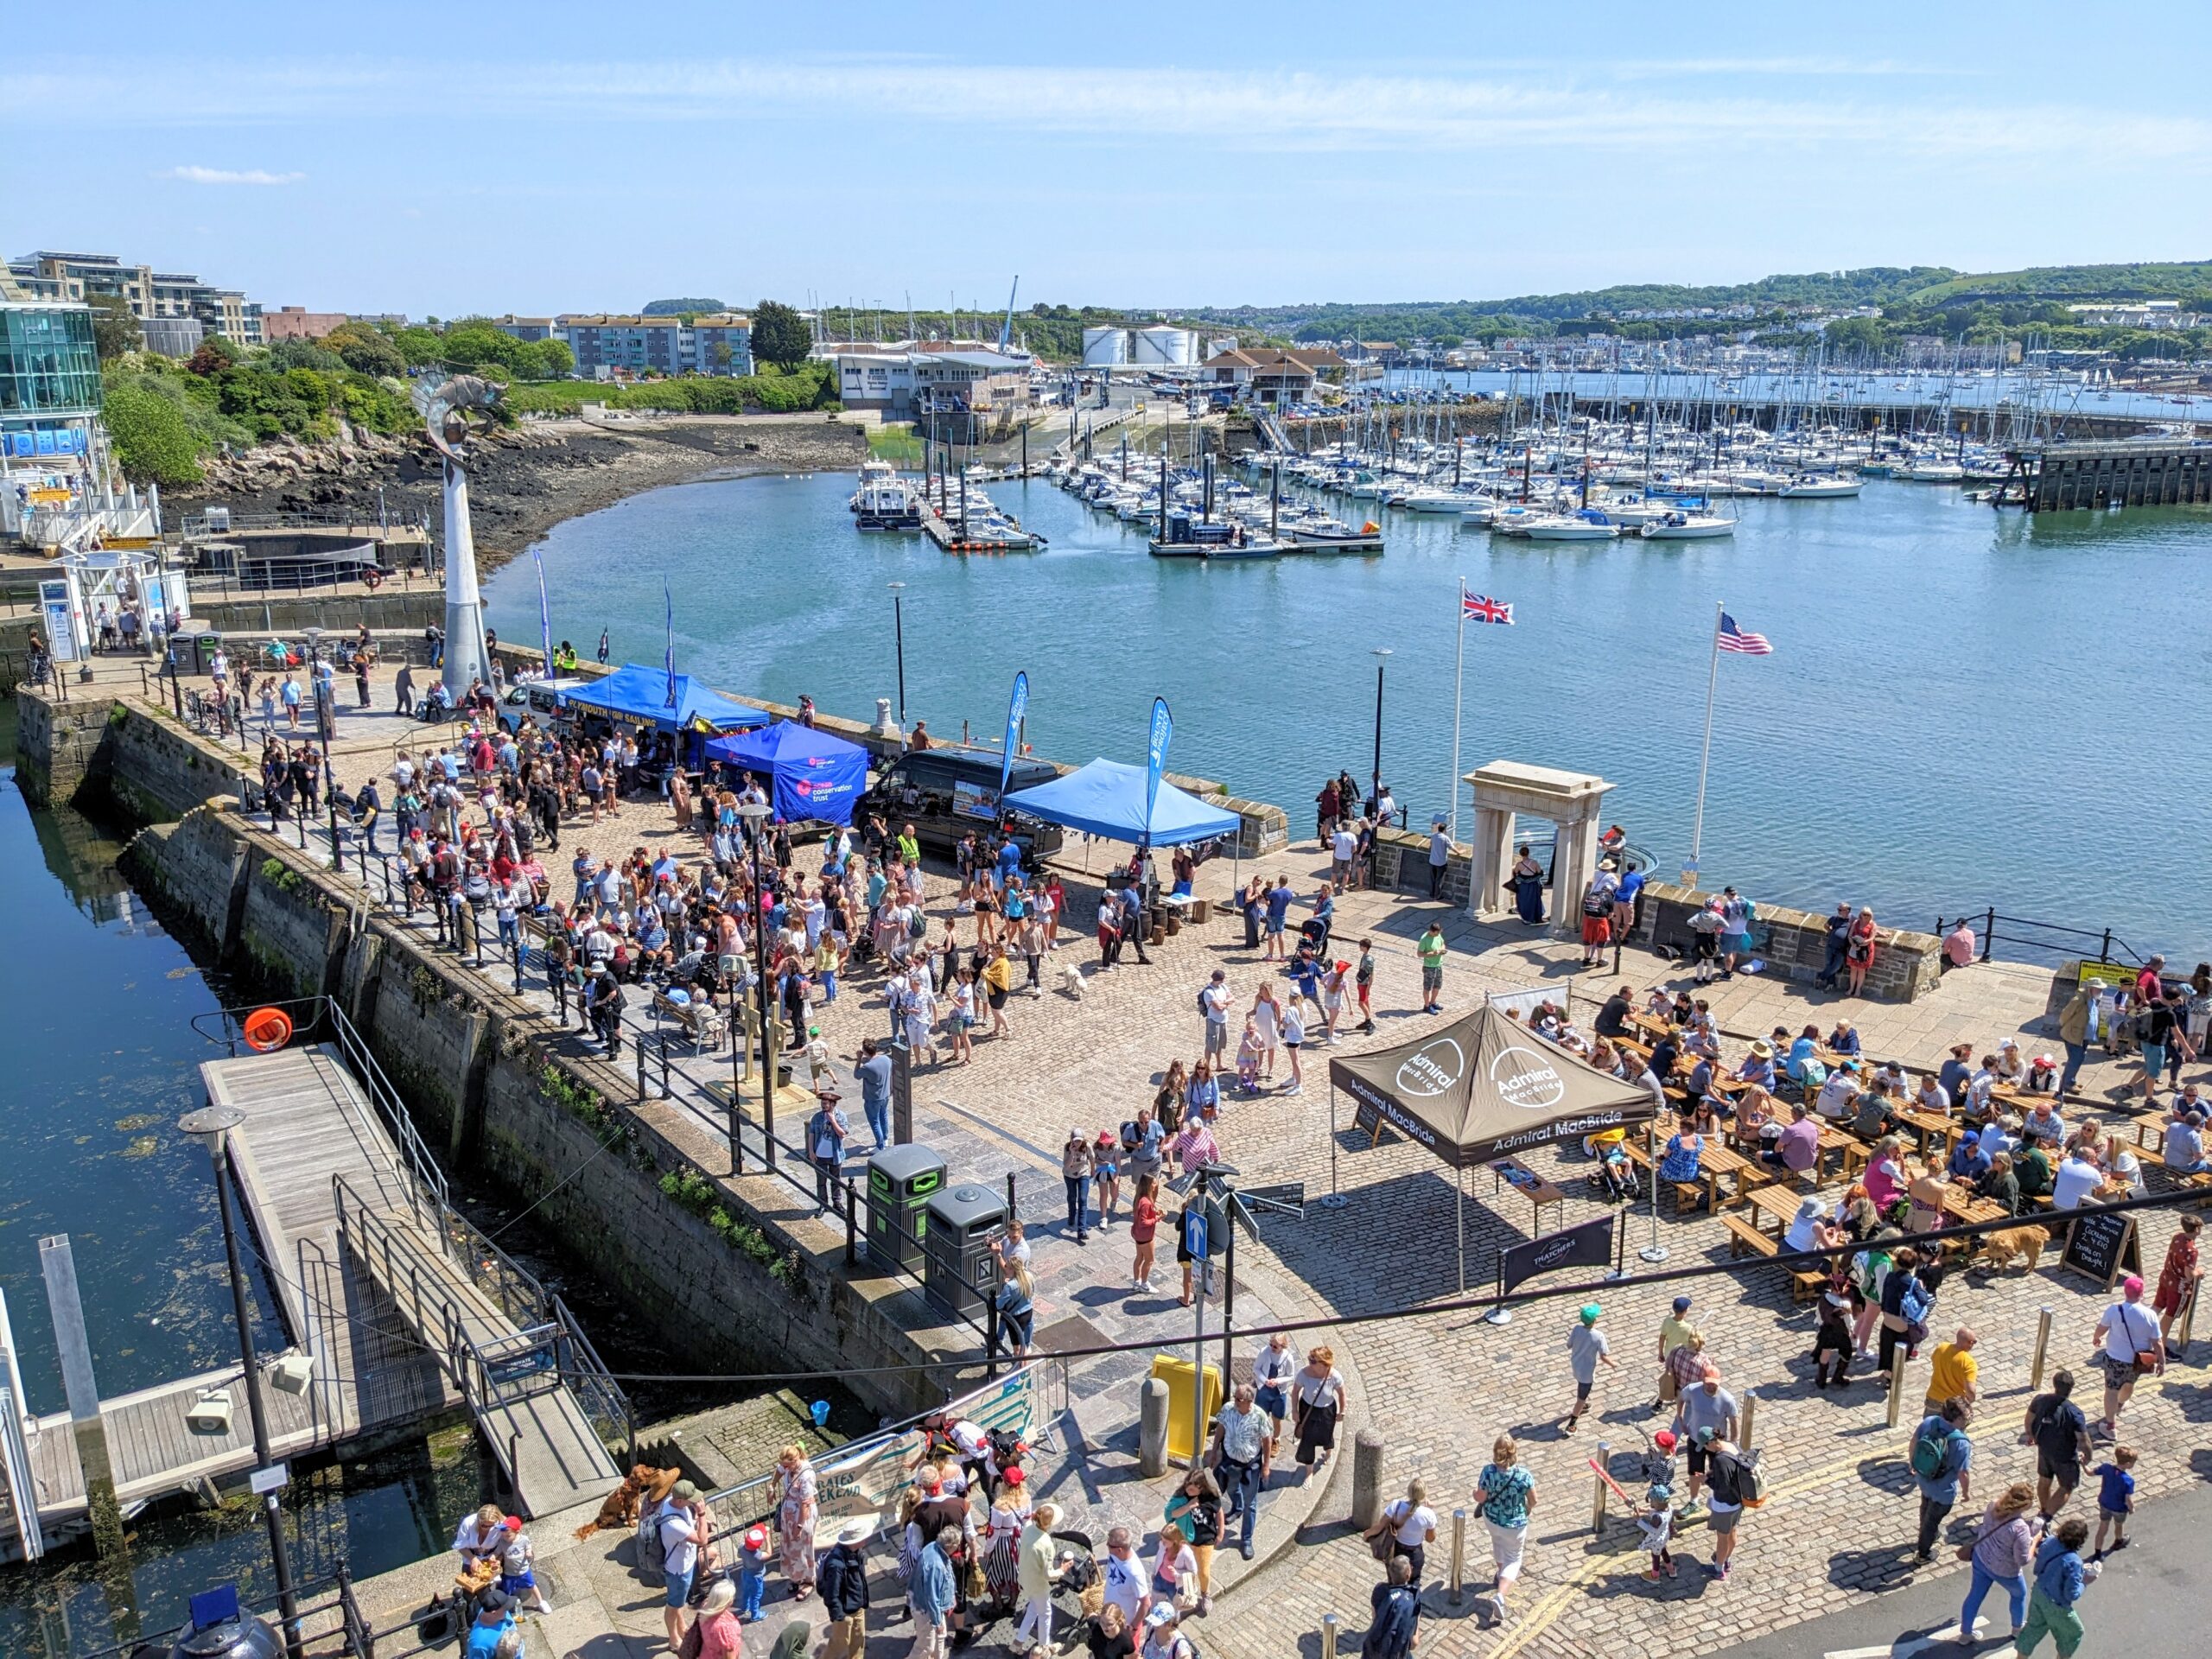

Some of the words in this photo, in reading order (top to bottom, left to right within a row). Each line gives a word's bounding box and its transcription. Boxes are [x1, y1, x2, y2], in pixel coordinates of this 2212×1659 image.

[569, 699, 608, 717] PLYMOUTH
[625, 714, 657, 728] SAILING
[1151, 708, 1164, 748] BOUNTY
[1157, 711, 1170, 753] PROJECT
[813, 785, 853, 796] conservation
[1402, 1062, 1439, 1094] MacBride
[1408, 1052, 1457, 1090] Admiral
[1497, 1065, 1559, 1096] Admiral
[1509, 1081, 1561, 1102] MacBride
[1351, 1078, 1386, 1111] Admiral
[1388, 1103, 1435, 1146] MacBride
[1492, 1126, 1550, 1152] Admiral
[1555, 1110, 1623, 1137] MacBride
[1534, 1238, 1576, 1265] THATCHERS
[2082, 1232, 2088, 1242] 2
[816, 1471, 855, 1489] RATES
[815, 1484, 861, 1506] EKEND
[841, 1503, 853, 1512] 2023
